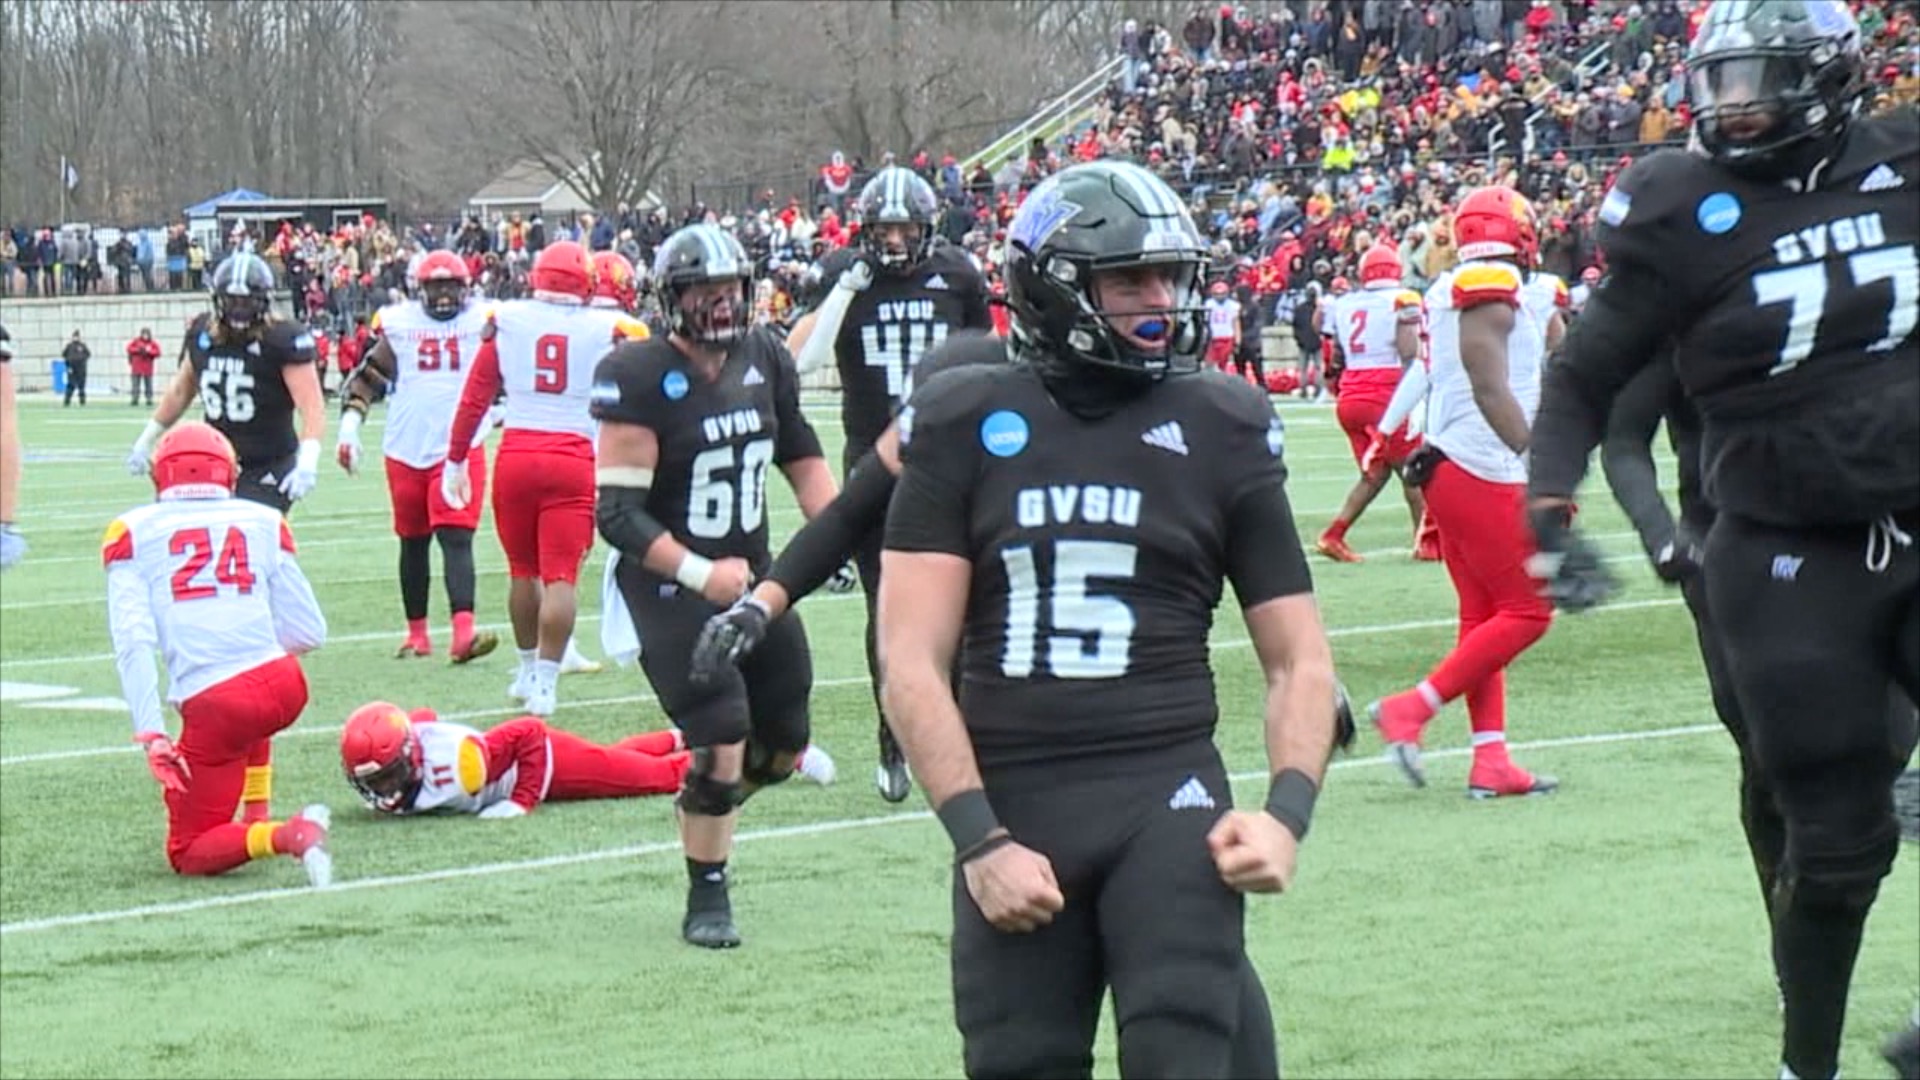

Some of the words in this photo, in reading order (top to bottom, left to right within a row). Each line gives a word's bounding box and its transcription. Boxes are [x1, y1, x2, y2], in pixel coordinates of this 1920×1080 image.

[1773, 212, 1885, 264] GVSU
[1349, 310, 1370, 354] 2
[1752, 245, 1919, 376] 77
[417, 337, 461, 371] 91
[535, 334, 569, 395] 9
[200, 368, 255, 422] 66
[687, 438, 775, 539] 60
[1017, 484, 1142, 528] GVSU
[168, 525, 257, 602] 24
[1001, 539, 1138, 679] 15
